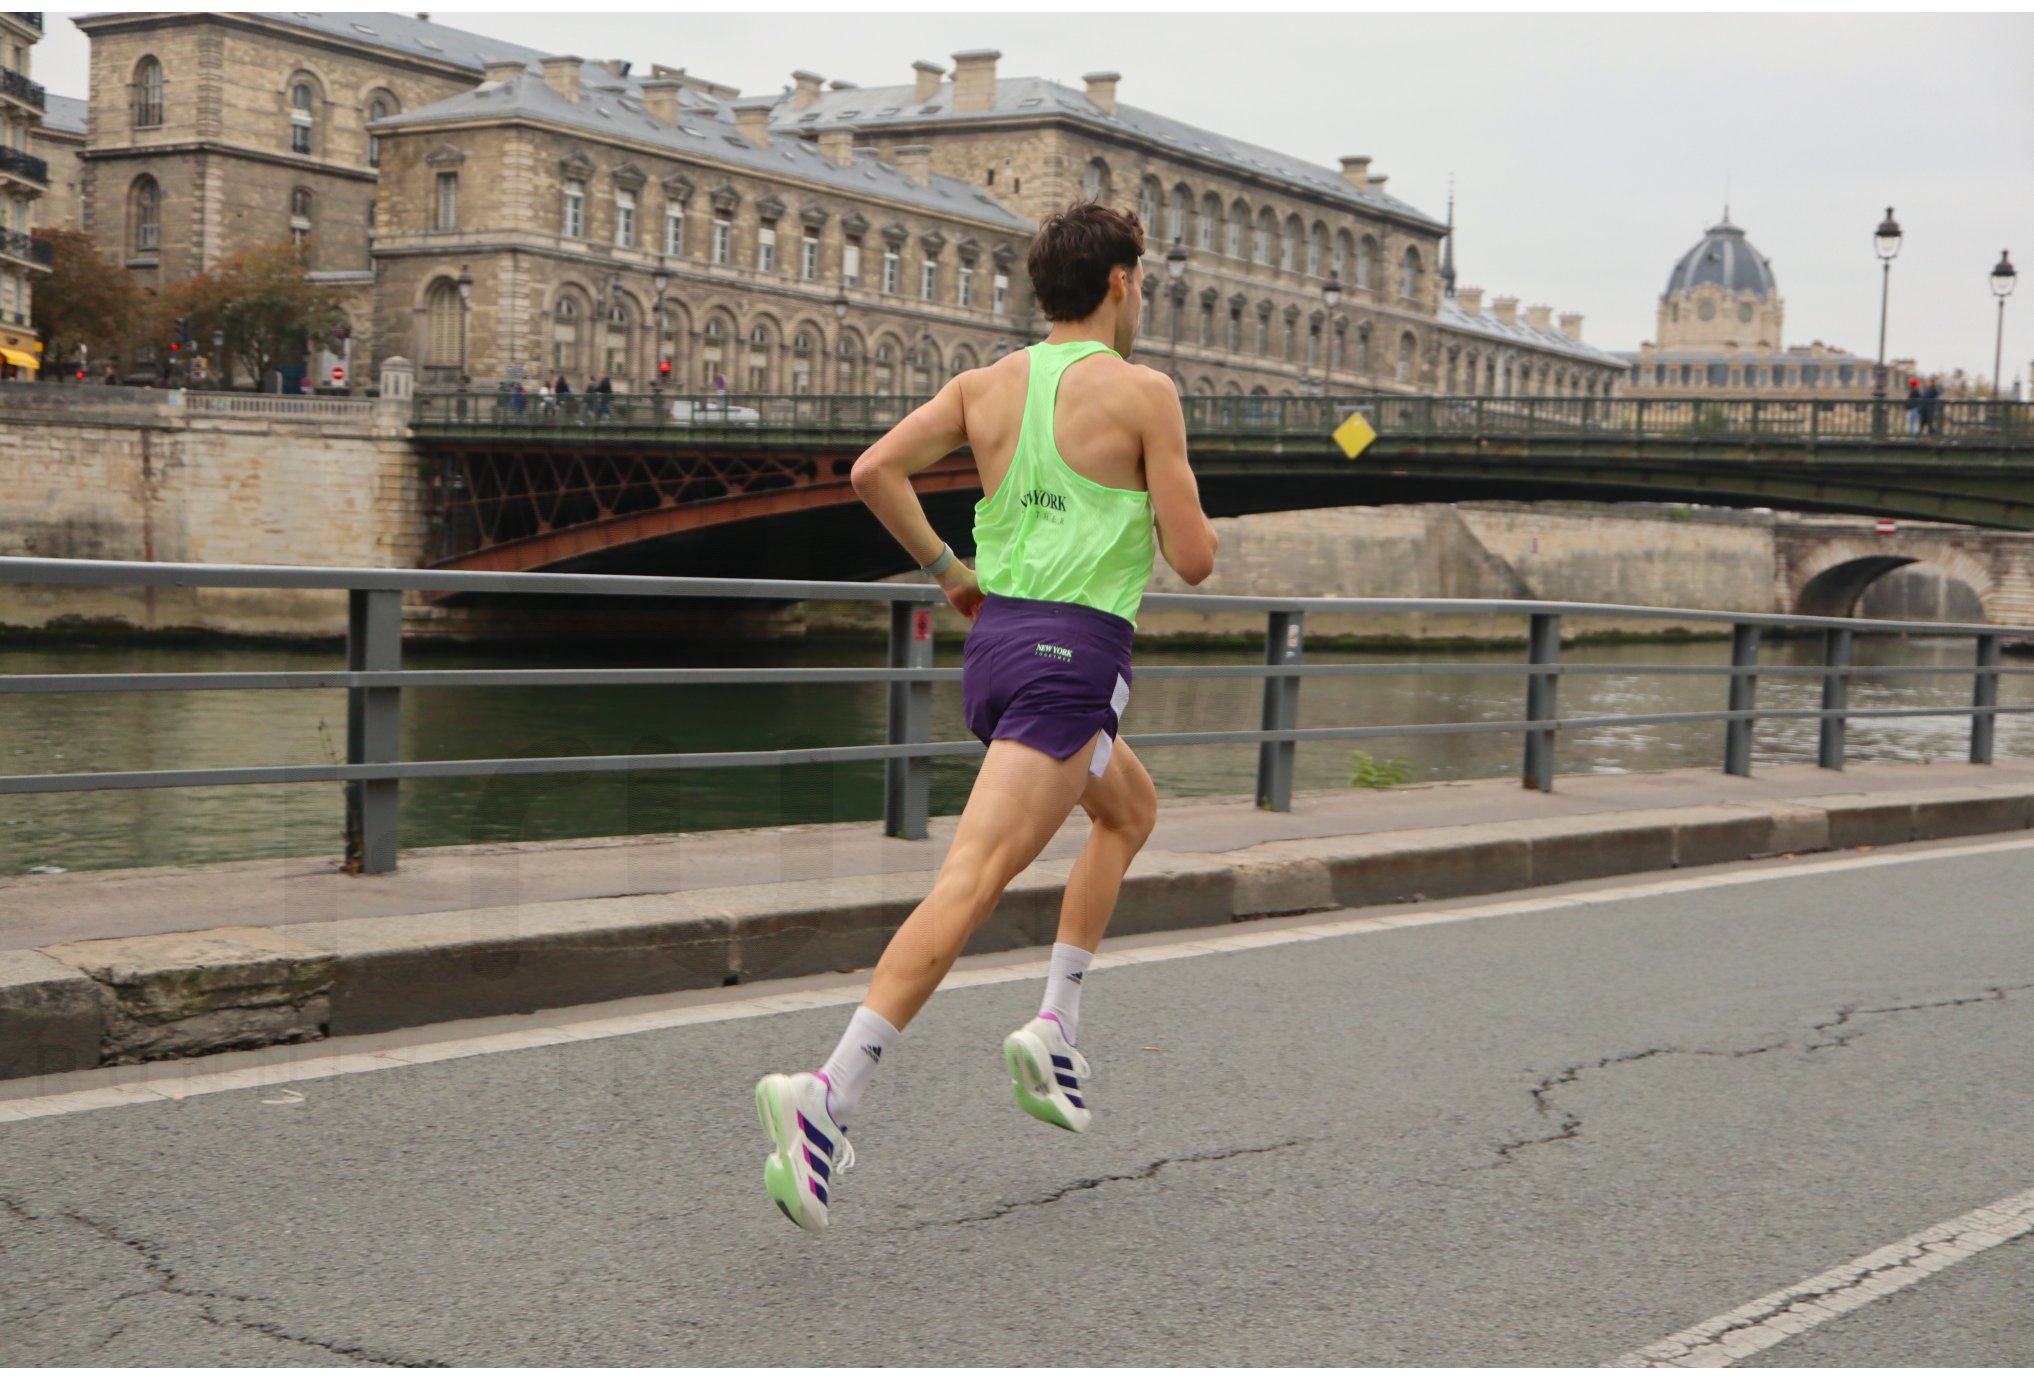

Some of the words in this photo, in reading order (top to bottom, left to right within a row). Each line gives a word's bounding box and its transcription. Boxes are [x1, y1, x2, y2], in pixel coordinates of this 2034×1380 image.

[1033, 489, 1066, 512] YORK
[1036, 643, 1053, 652] NEW
[1053, 645, 1073, 657] YORK
